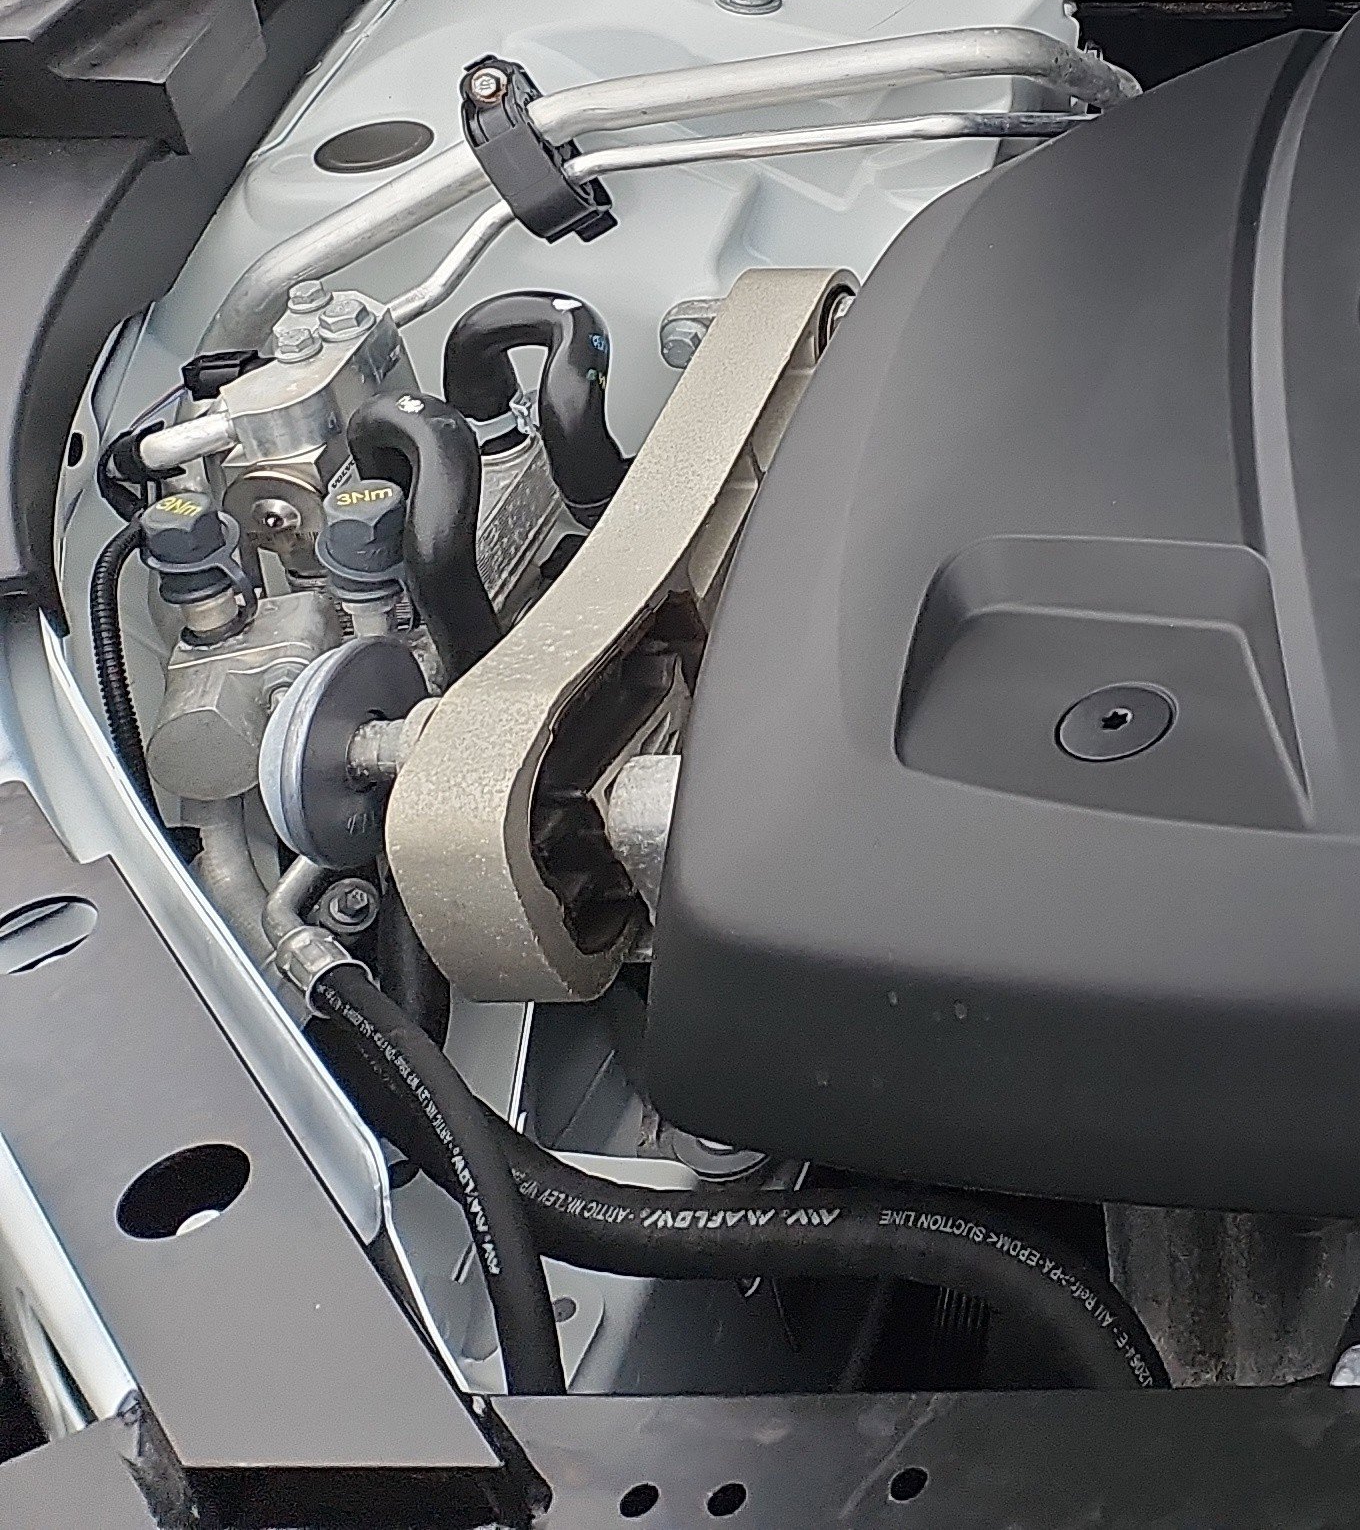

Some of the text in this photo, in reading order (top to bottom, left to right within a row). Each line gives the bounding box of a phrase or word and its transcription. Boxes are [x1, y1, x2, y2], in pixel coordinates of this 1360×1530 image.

[155, 496, 203, 517] 3Nm
[336, 486, 394, 507] 3Nm
[878, 1209, 916, 1227] LINE
[917, 1213, 987, 1243] SUCTION
